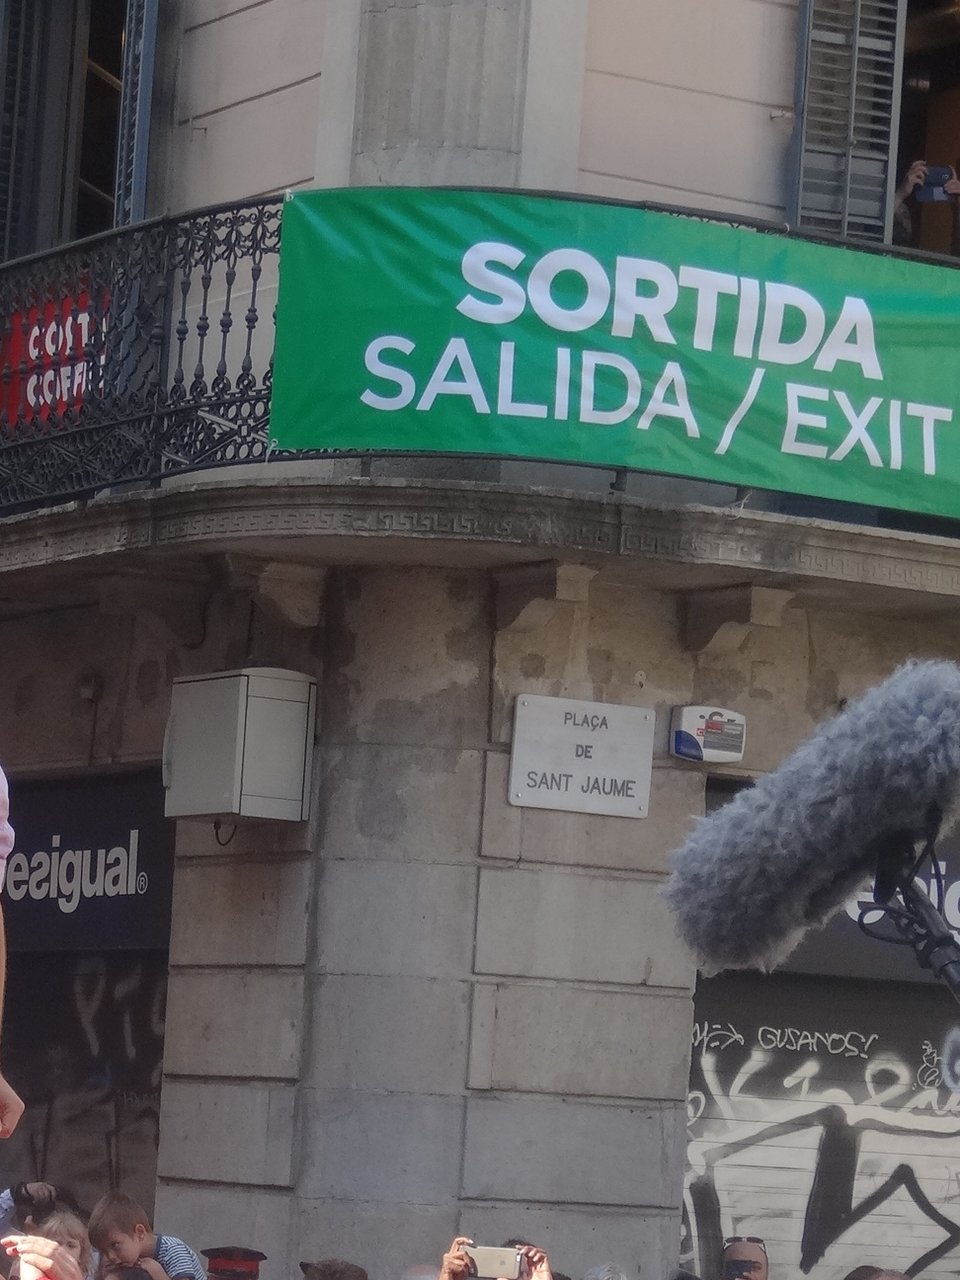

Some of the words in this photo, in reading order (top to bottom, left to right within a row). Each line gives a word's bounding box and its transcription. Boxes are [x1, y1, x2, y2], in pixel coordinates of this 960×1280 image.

[455, 241, 884, 381] SORTIDA
[360, 335, 701, 439] SALIDA
[780, 382, 953, 476] EXIT
[563, 711, 609, 732] PLAÇA
[575, 743, 594, 759] DE
[525, 771, 573, 792] SANT
[581, 775, 637, 799] JAUME
[6, 829, 139, 914] esigual
